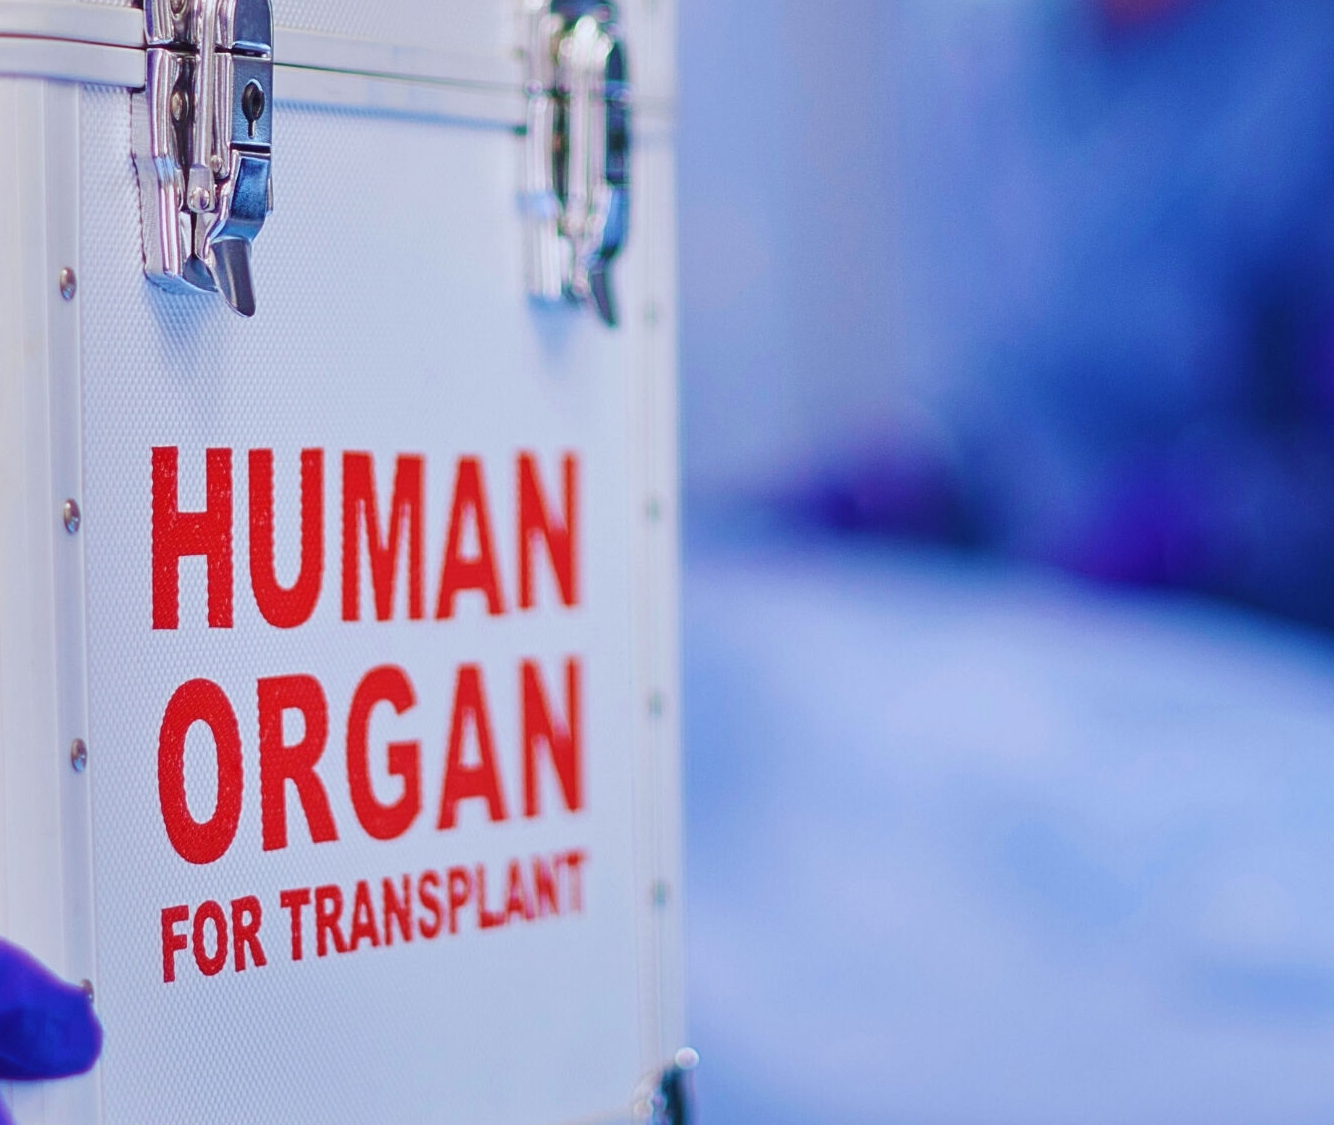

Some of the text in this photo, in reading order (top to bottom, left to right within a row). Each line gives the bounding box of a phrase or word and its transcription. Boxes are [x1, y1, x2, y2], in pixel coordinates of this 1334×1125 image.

[151, 446, 581, 630] HUMAN
[157, 656, 584, 865] ORGAN
[161, 849, 586, 983] FOR TRANSPLANT
